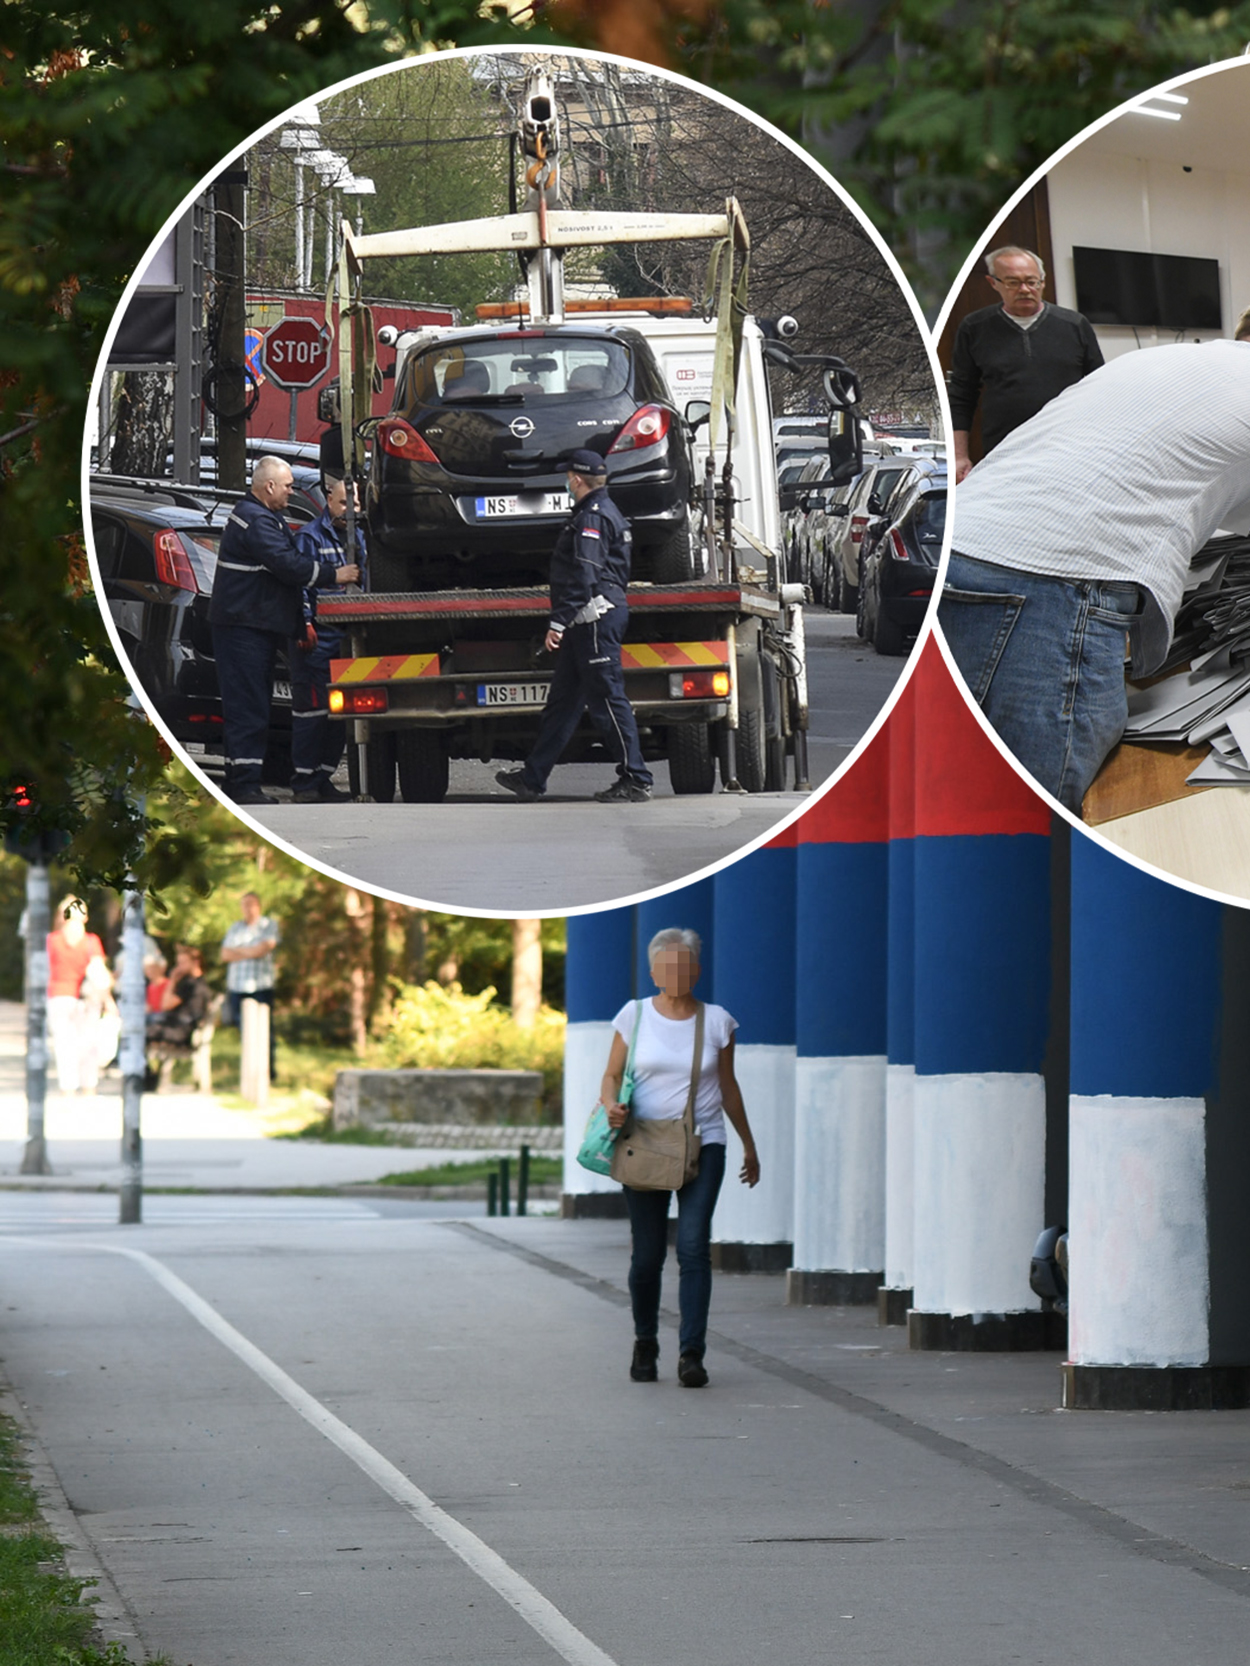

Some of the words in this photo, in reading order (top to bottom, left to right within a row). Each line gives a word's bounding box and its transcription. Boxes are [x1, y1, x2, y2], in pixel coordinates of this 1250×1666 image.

[558, 225, 595, 233] NOSIVOST
[272, 340, 321, 364] STOP
[487, 498, 506, 514] NS
[489, 687, 508, 703] NS
